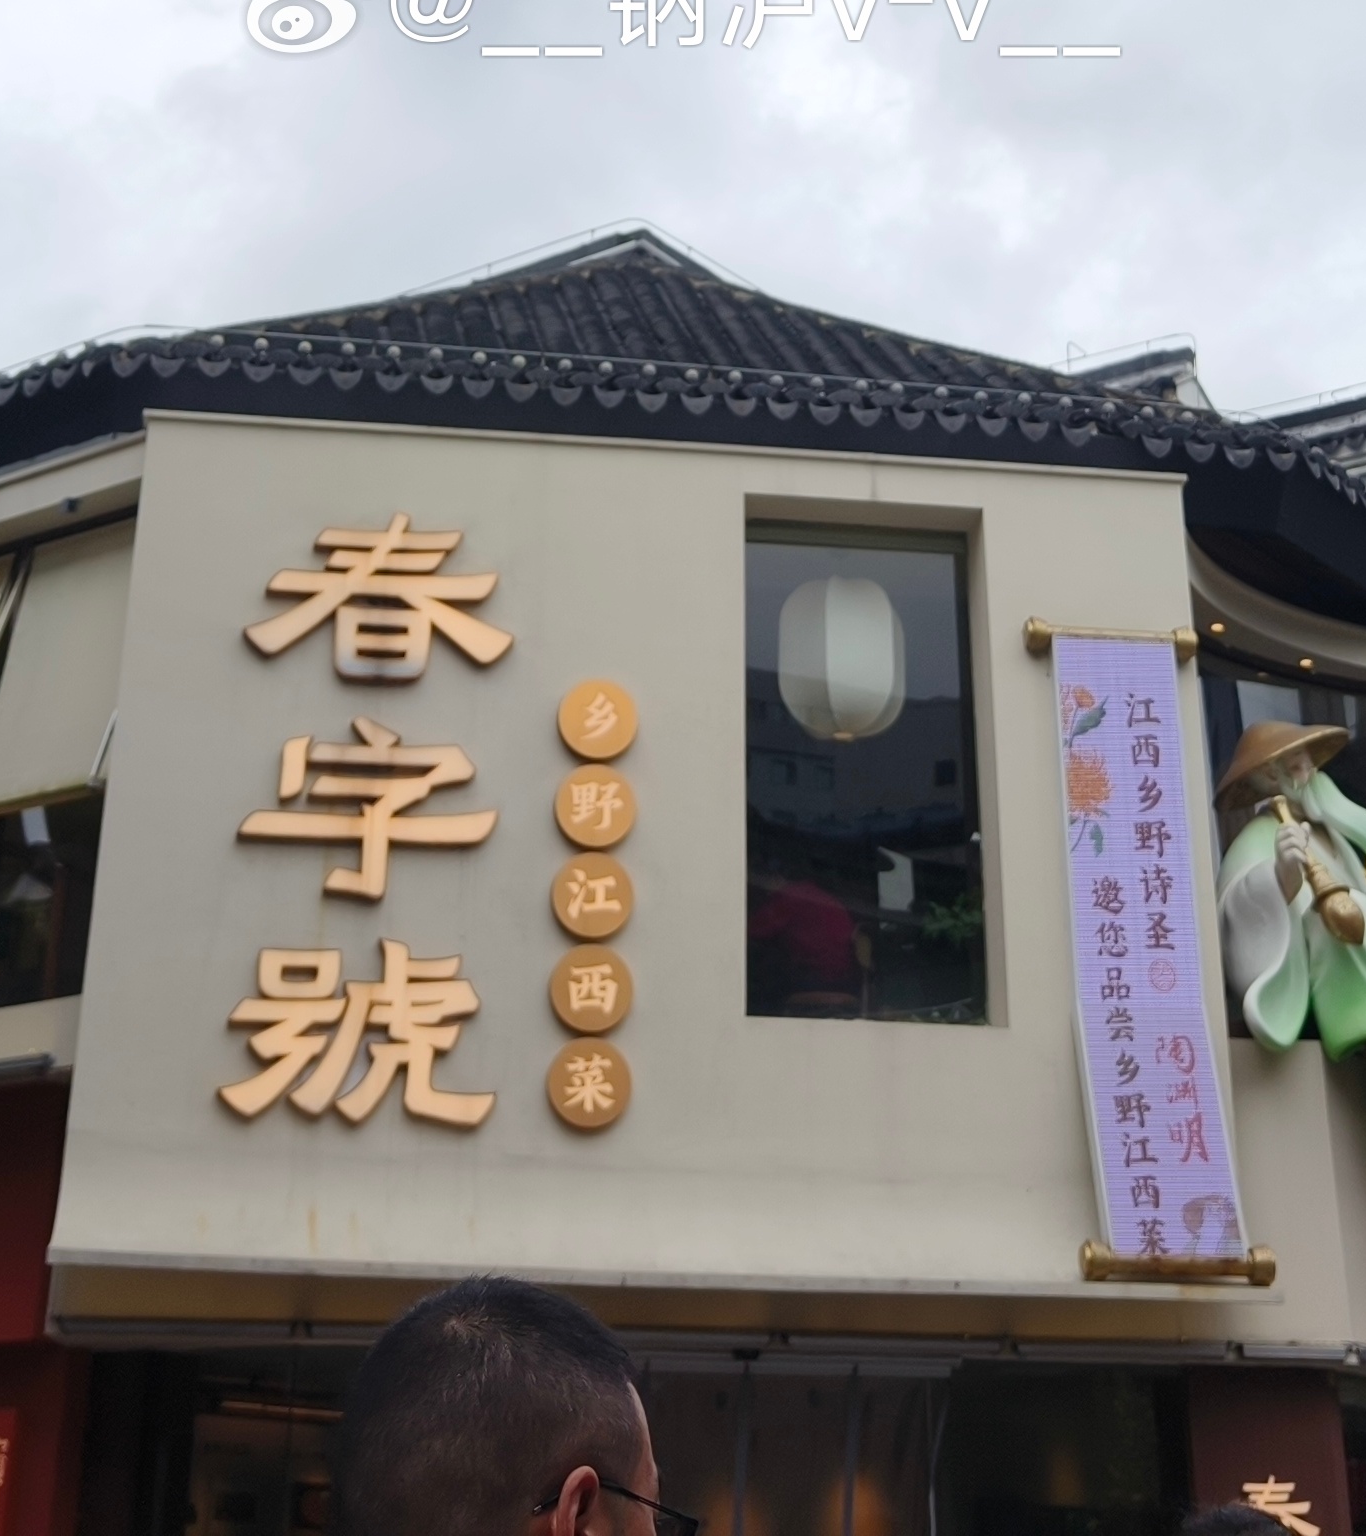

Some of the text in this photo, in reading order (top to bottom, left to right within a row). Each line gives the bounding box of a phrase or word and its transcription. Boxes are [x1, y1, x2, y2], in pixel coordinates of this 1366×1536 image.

[217, 512, 514, 1128] 春字號
[563, 691, 624, 1113] 乡野江西菜
[1125, 693, 1176, 951] 江西乡野诗圣
[1092, 876, 1170, 1255] 邀您品尝乡野江西菜
